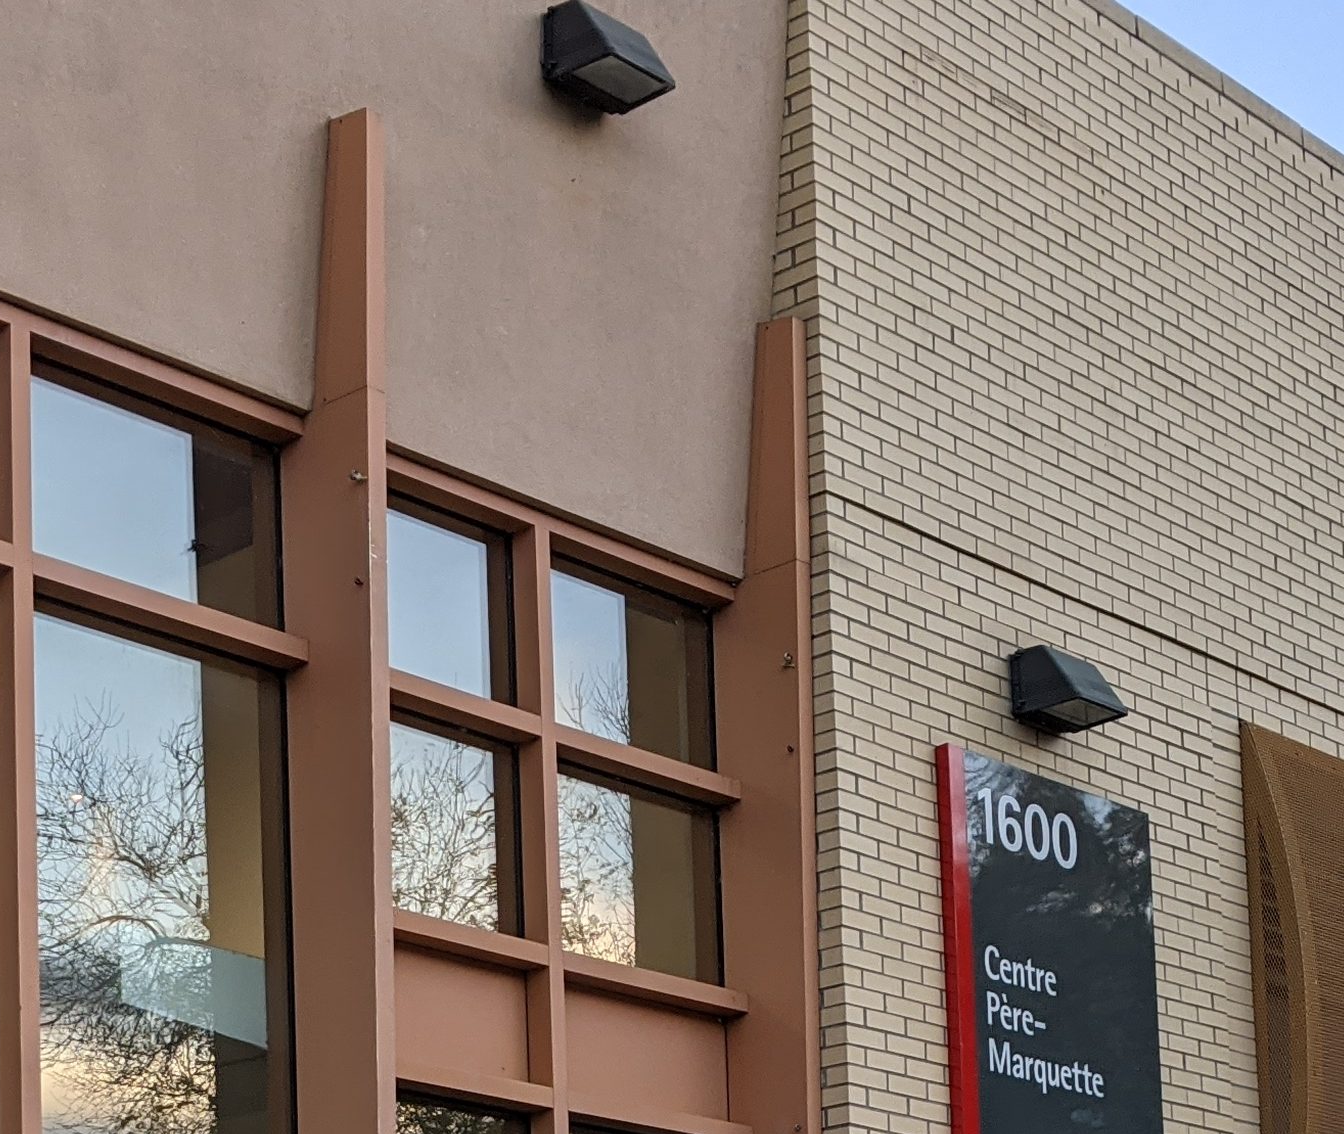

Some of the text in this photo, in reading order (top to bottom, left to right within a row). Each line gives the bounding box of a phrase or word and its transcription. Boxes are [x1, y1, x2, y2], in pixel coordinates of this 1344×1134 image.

[977, 787, 1078, 870] 1600
[984, 944, 1057, 997] Centre
[986, 991, 1046, 1036] Père-
[987, 1036, 1105, 1098] Marquette
